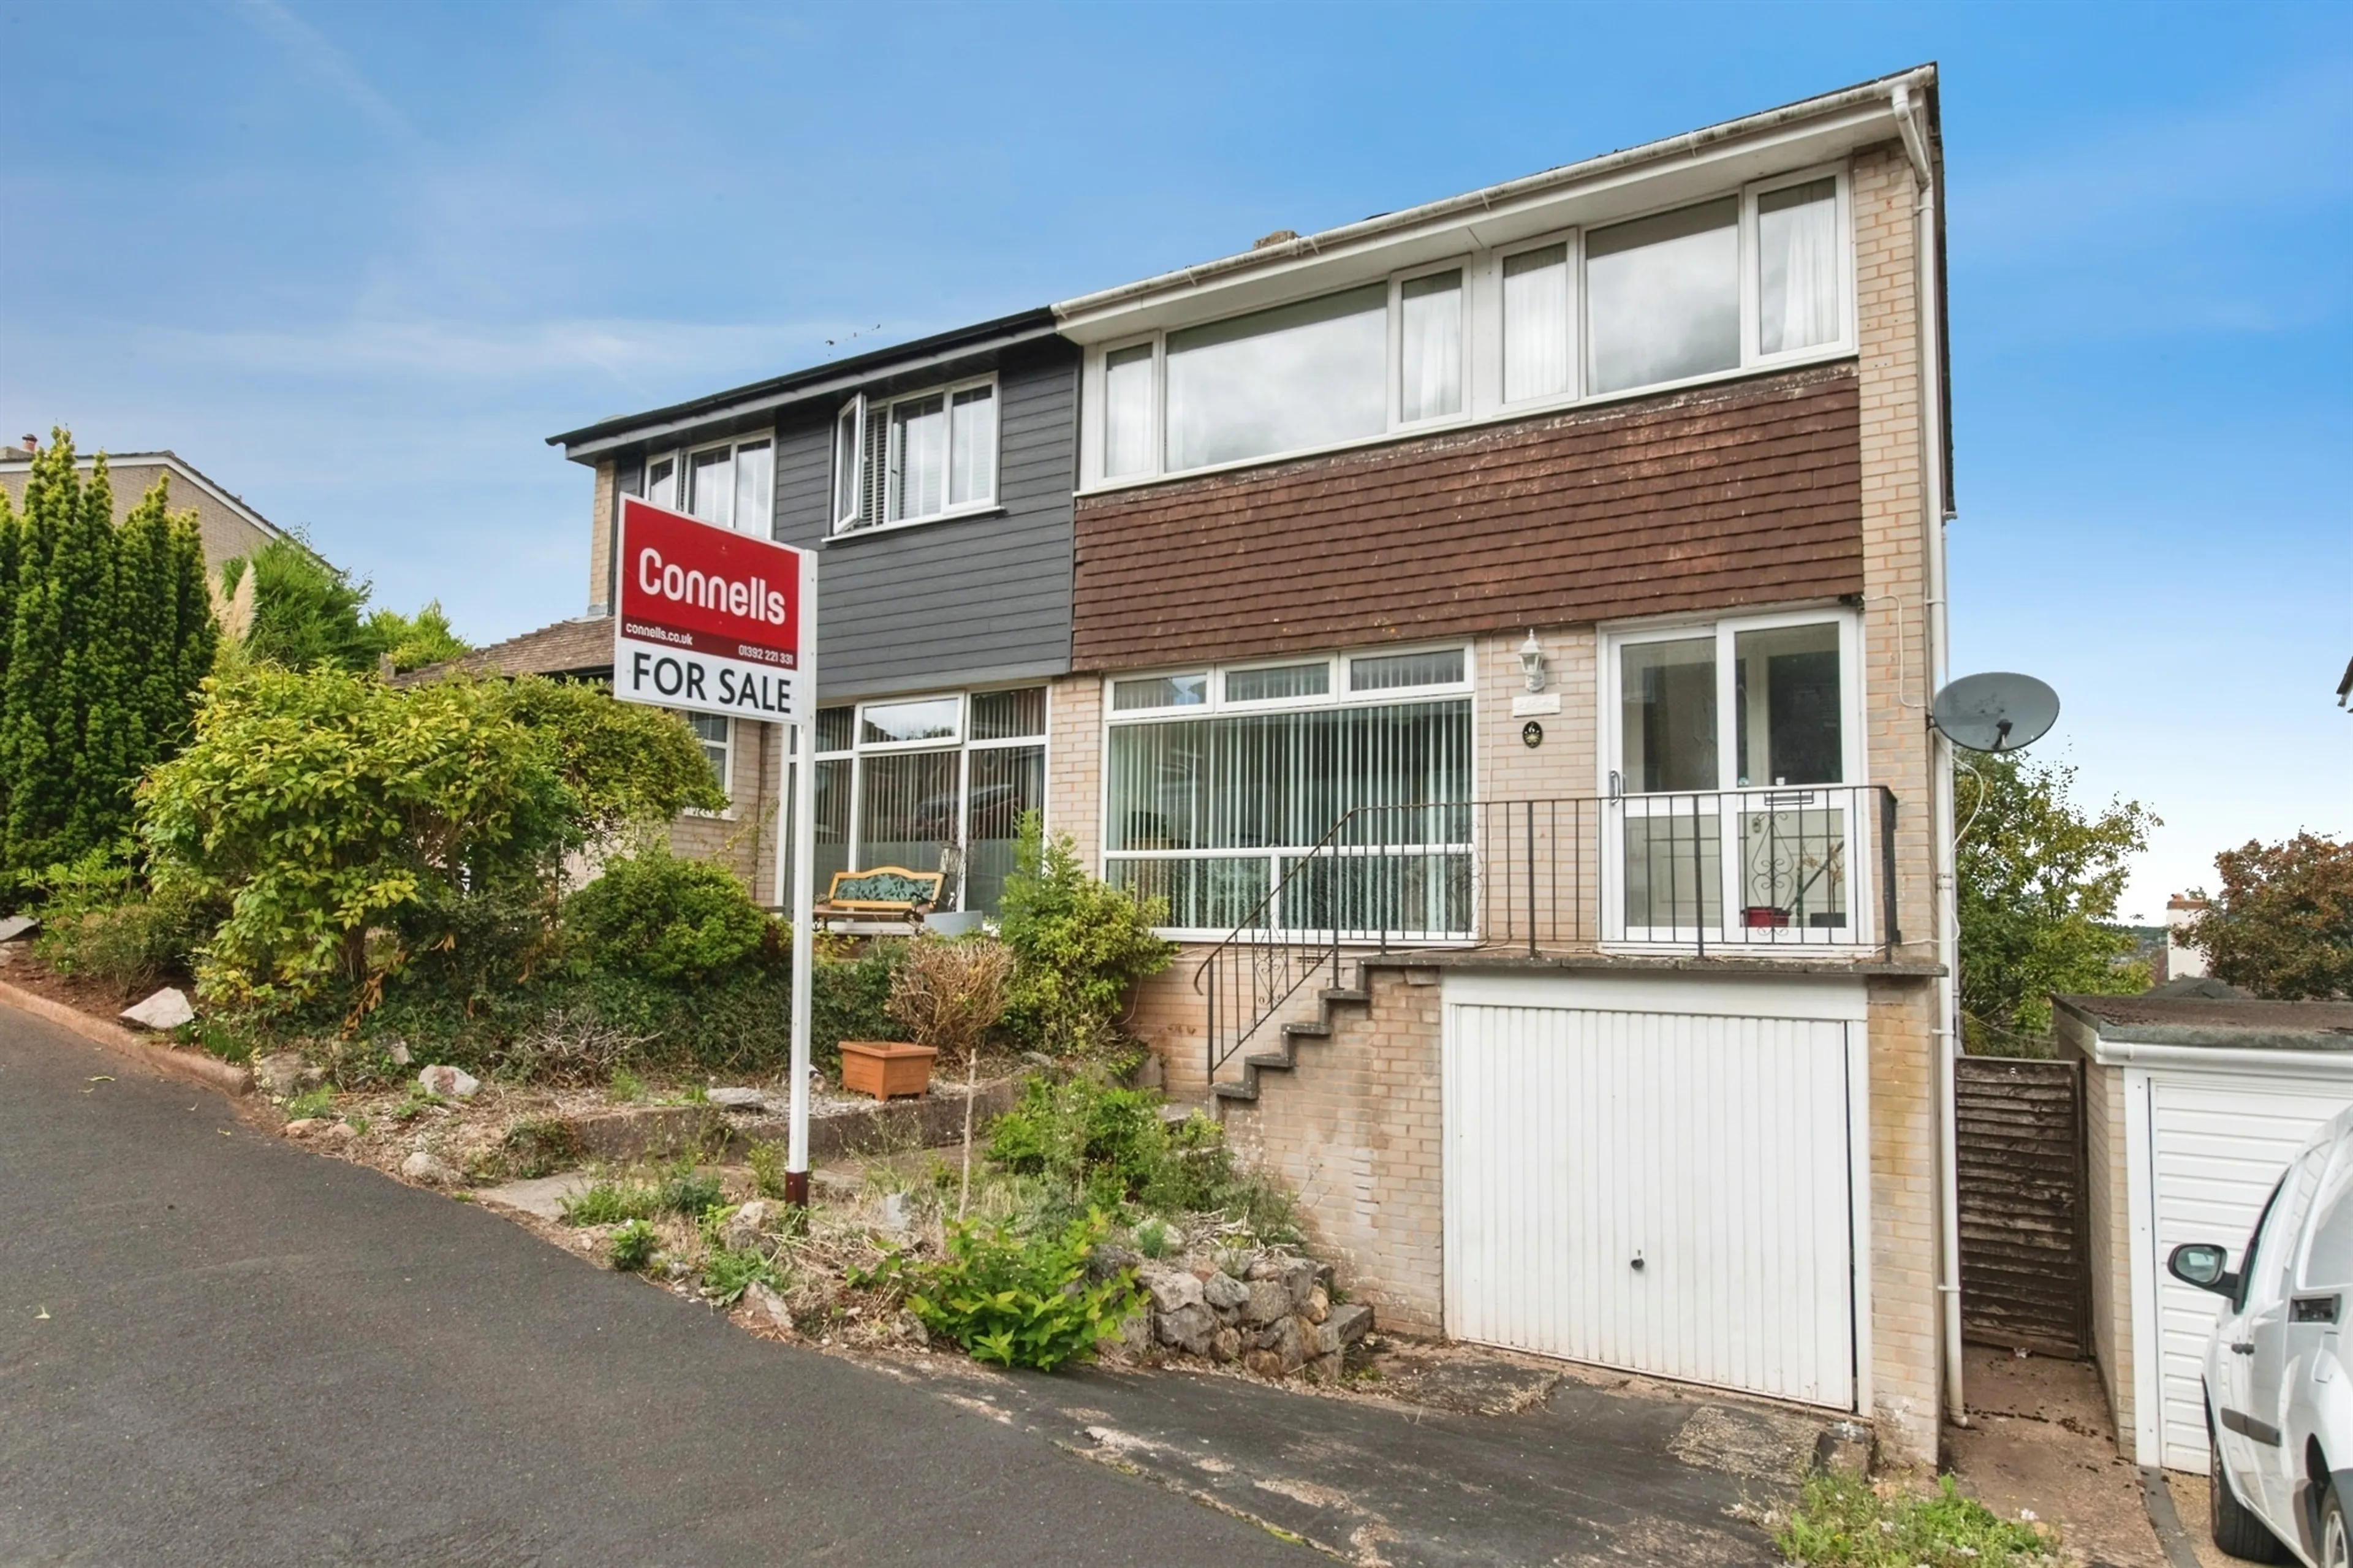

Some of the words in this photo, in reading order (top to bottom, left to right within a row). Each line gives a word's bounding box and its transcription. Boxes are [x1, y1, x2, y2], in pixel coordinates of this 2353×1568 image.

[639, 547, 785, 625] Connells
[626, 623, 693, 646] connells.co.uk
[738, 645, 763, 659] 01392
[764, 650, 779, 662] 221
[779, 653, 794, 665] 331
[634, 651, 707, 701] FOR
[718, 668, 791, 714] SALE
